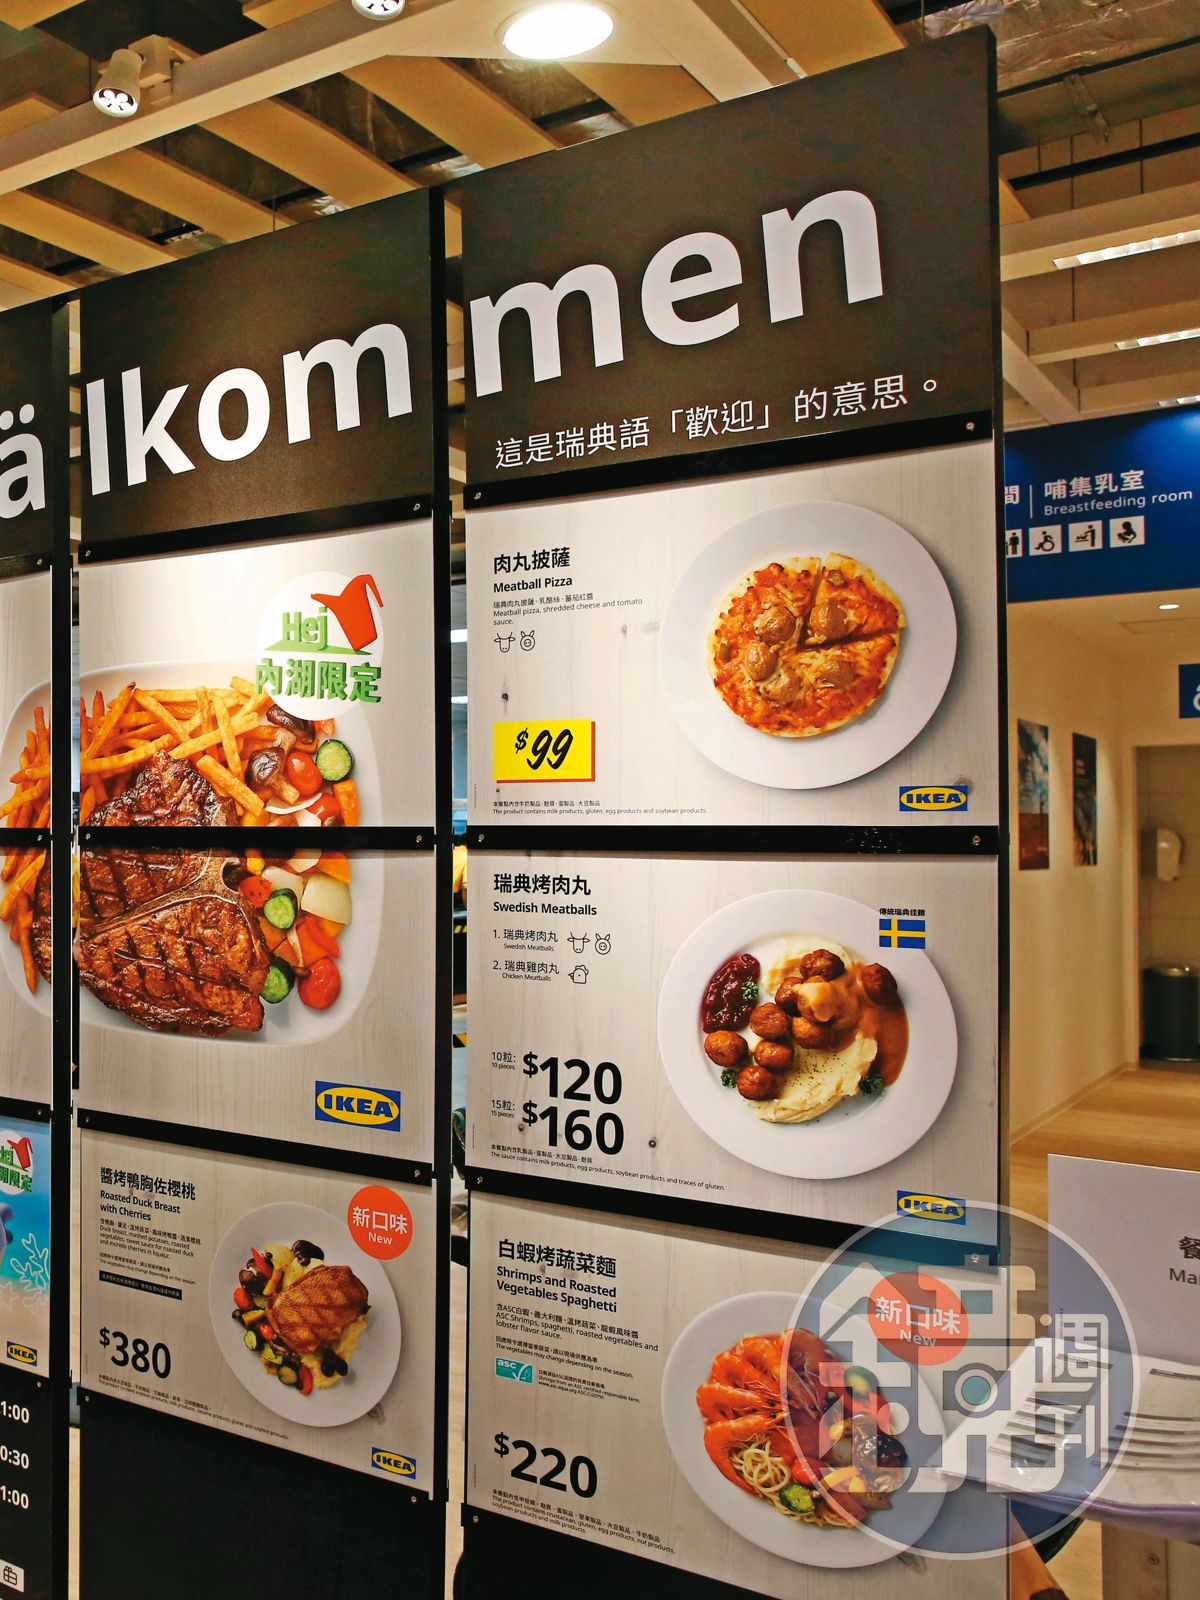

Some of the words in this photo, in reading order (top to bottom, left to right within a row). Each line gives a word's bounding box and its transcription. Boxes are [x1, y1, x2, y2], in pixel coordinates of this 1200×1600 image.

[1044, 469, 1144, 500] 哺集乳室
[1044, 496, 1146, 516] Breastfeeding
[1152, 490, 1192, 503] room
[494, 547, 570, 574] 肉丸披薩
[494, 578, 541, 592] Meatball
[545, 577, 572, 587] Pizza
[494, 609, 521, 617] Meatball
[523, 606, 541, 616] pizza,
[543, 604, 574, 613] shredded
[617, 598, 643, 606] tomato
[282, 606, 328, 650] Hej
[256, 658, 382, 703] 內湖限定
[515, 728, 573, 770] $99
[906, 793, 962, 803] IKEA
[494, 873, 591, 896] 瑞典烤肉丸
[494, 901, 538, 913] Swedish
[541, 903, 597, 916] Meatballs
[493, 930, 500, 938] 1.
[504, 928, 558, 942] 瑞典烤肉丸
[493, 961, 501, 970] 2.
[505, 960, 559, 974] 瑞典雞肉丸
[523, 1052, 622, 1104] $120
[324, 1094, 393, 1118] IKEA
[522, 1100, 624, 1155] $160
[100, 1166, 196, 1200] 醬烤鴨胸佐櫻桃
[100, 1190, 130, 1204] Roasted
[133, 1196, 152, 1208] Duck
[155, 1201, 180, 1214] Breast
[100, 1204, 117, 1214] with
[120, 1206, 151, 1221] Cherries
[904, 1199, 961, 1217] IKEA
[353, 1206, 408, 1235] 新口味
[368, 1232, 392, 1245] New
[499, 1239, 616, 1278] 白蝦烤蔬菜麵
[497, 1266, 542, 1284] Shrimps
[545, 1276, 566, 1288] and
[570, 1280, 616, 1298] Roasted
[497, 1280, 558, 1301] Vegetables
[561, 1293, 617, 1312] Spaghetti
[874, 1295, 962, 1336] 新口味
[496, 1321, 519, 1330] lobster
[520, 1326, 540, 1334] flavor
[541, 1330, 562, 1339] sauce.
[496, 1312, 509, 1320] ASC
[511, 1314, 540, 1327] Shrimps,
[541, 1321, 575, 1335] spaghetti,
[576, 1328, 603, 1339] roasted
[604, 1334, 643, 1349] vegetables
[644, 1343, 658, 1352] and
[899, 1330, 936, 1348] New
[9, 1347, 34, 1360] IKEA
[100, 1327, 171, 1378] $380
[498, 1360, 516, 1369] asc
[376, 1455, 413, 1472] IKEA
[494, 1432, 598, 1498] $220
